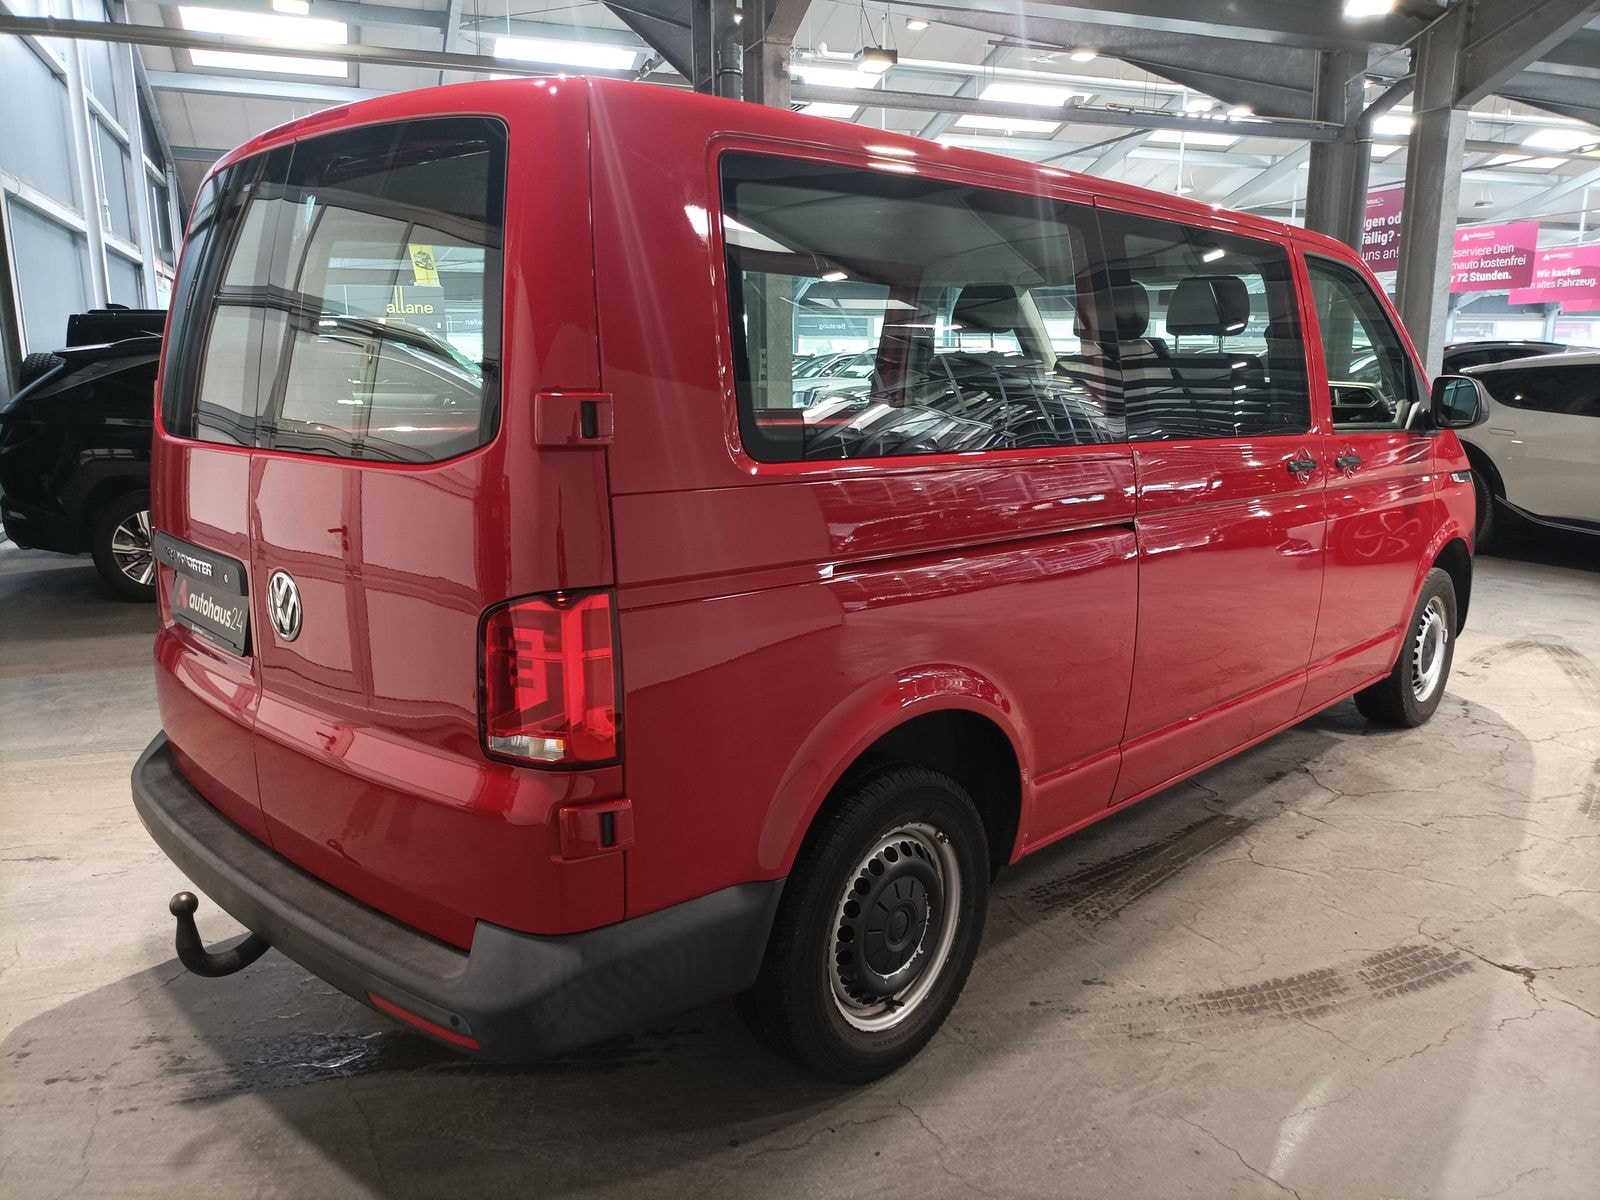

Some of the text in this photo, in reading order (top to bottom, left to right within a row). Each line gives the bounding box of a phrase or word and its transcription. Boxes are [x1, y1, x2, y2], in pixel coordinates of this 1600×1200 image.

[1388, 211, 1402, 225] od
[1362, 246, 1399, 261] uns an!
[1452, 243, 1514, 258] eserviere Dein
[1451, 254, 1527, 271] mauto kostenfrei
[1457, 273, 1468, 283] 72
[1469, 269, 1512, 282] Stunden.
[1536, 266, 1581, 278] Wir kaufen
[1536, 279, 1556, 289] altes
[1557, 277, 1598, 288] Fahrzeug.
[386, 285, 434, 314] allane
[189, 592, 243, 633] autohaus24
